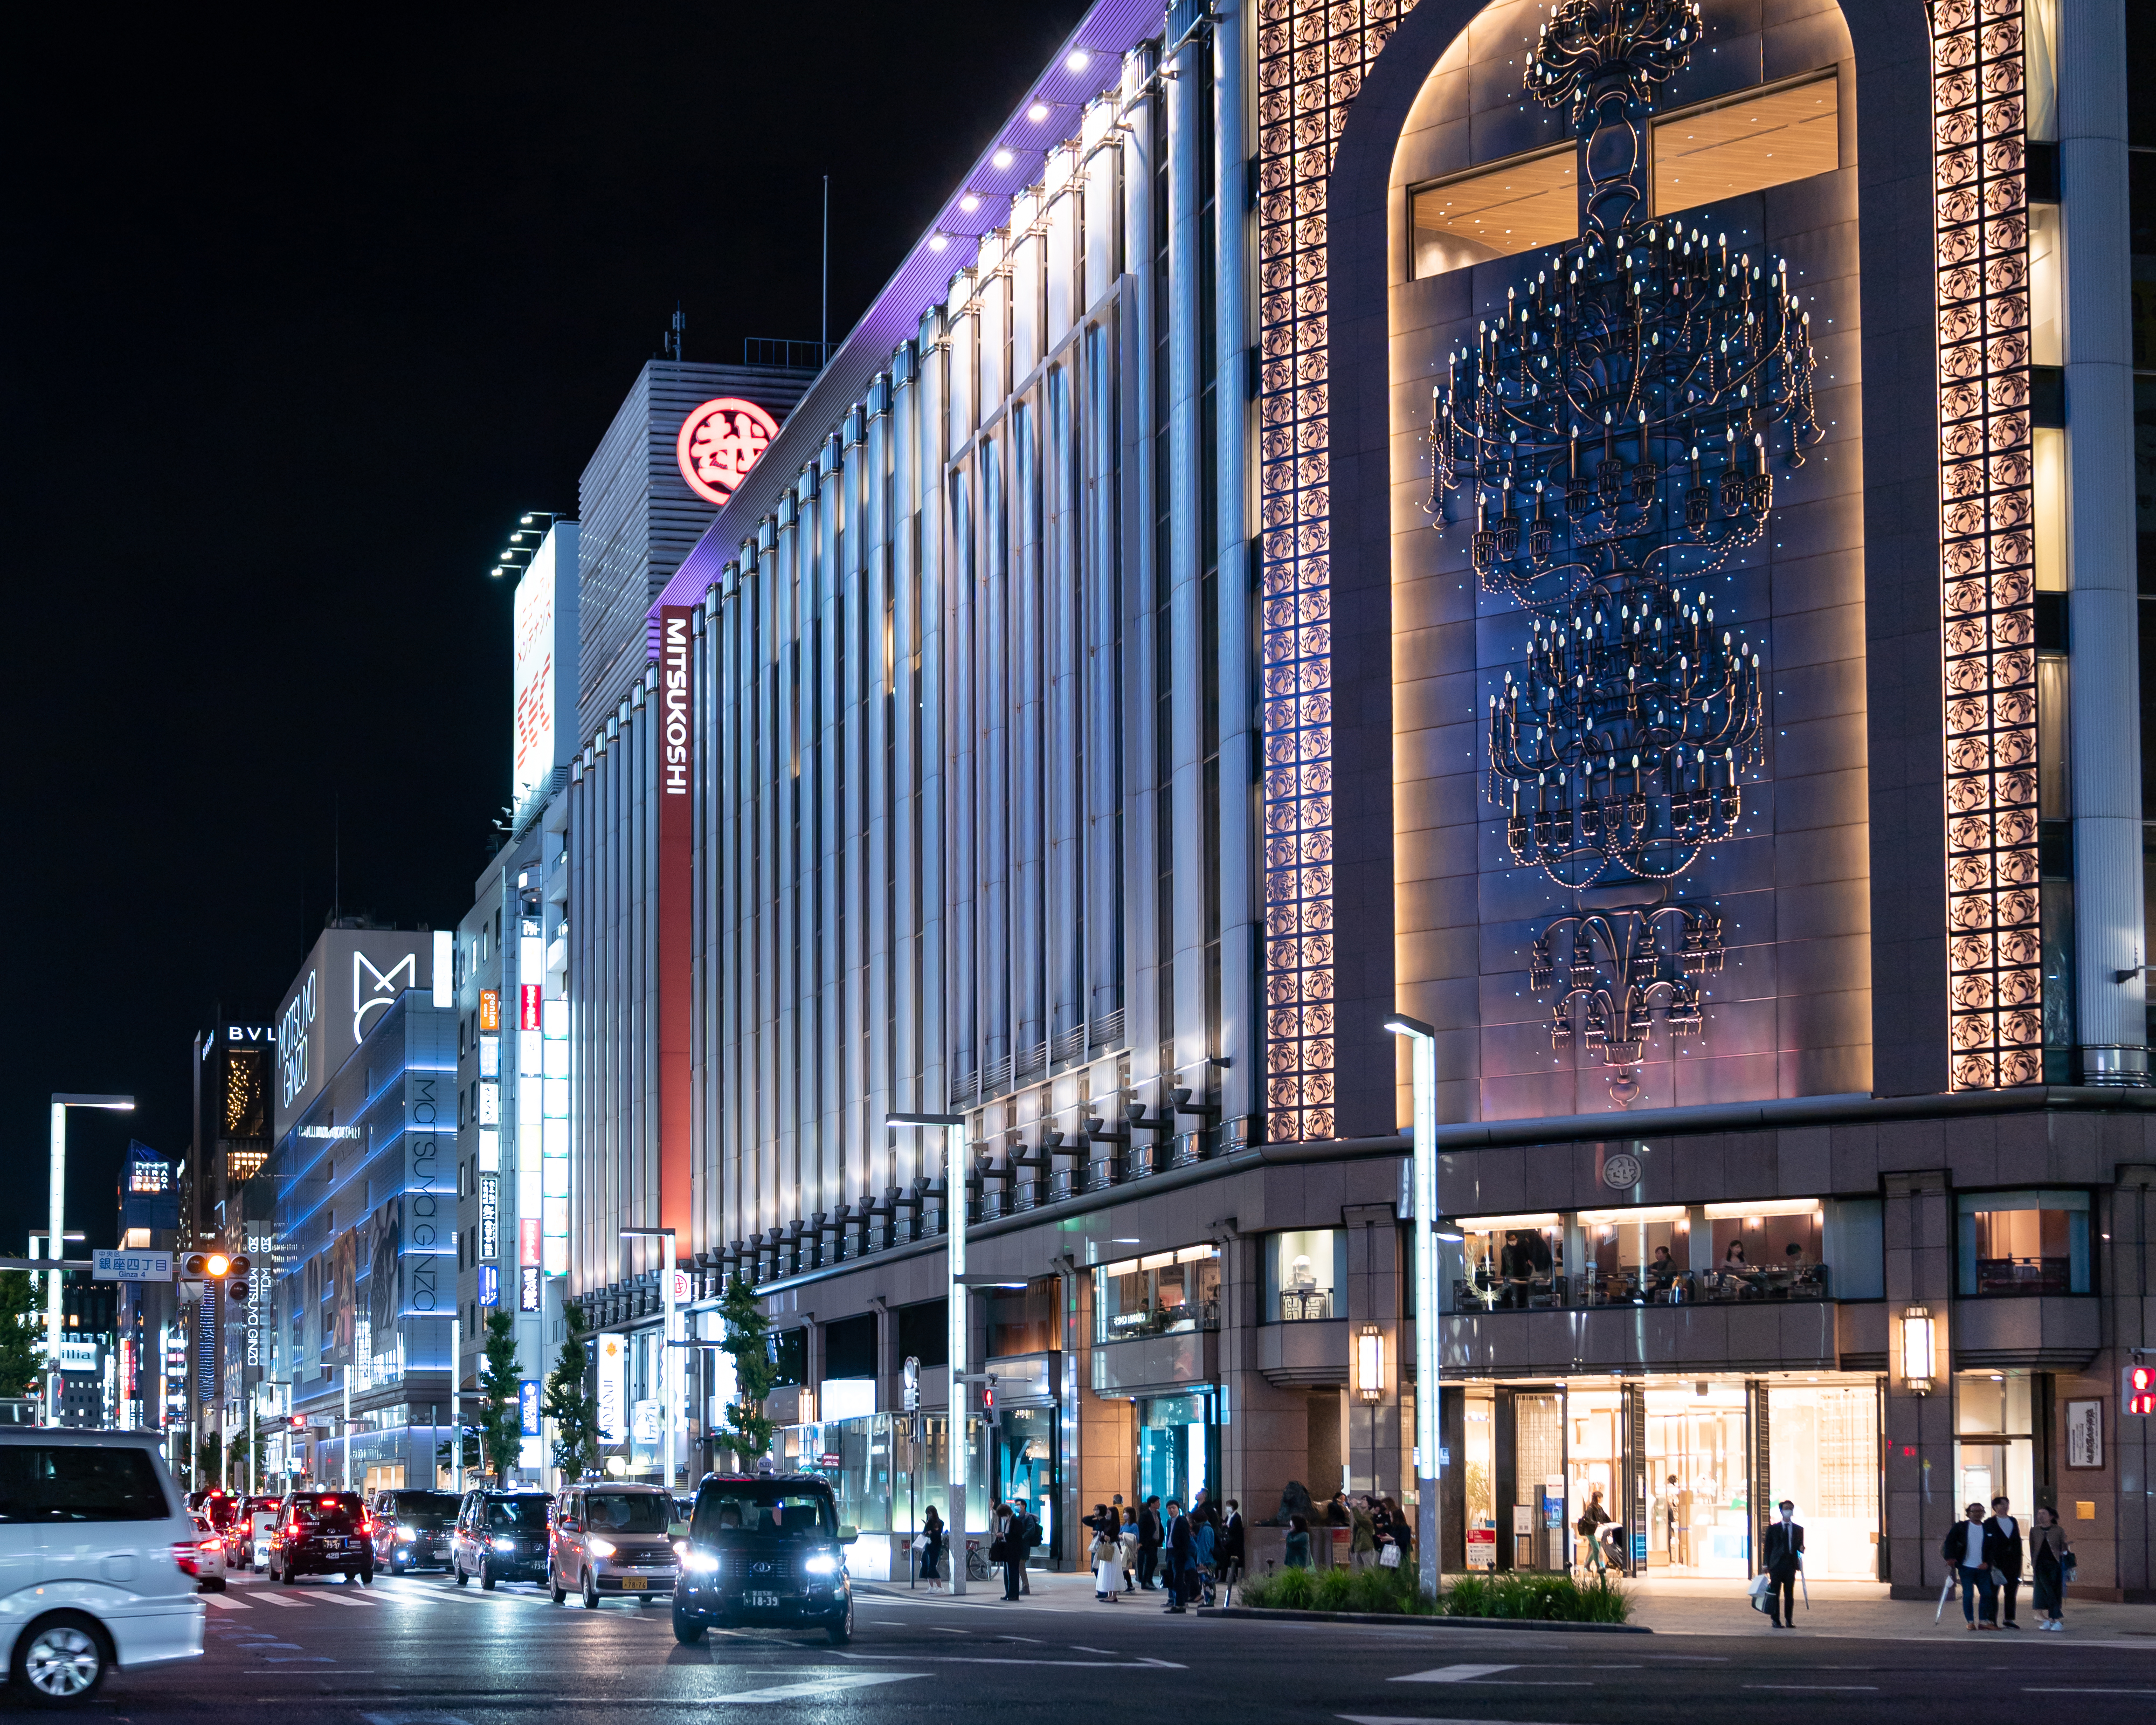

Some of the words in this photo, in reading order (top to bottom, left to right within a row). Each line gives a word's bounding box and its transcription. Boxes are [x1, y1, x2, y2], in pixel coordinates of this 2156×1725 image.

[517, 599, 551, 671] メンテナンス
[667, 618, 687, 794] MITSUKOSHI
[483, 993, 496, 1026] genten
[99, 1258, 167, 1271] 銀座四丁目
[753, 1596, 778, 1606] 18-39
